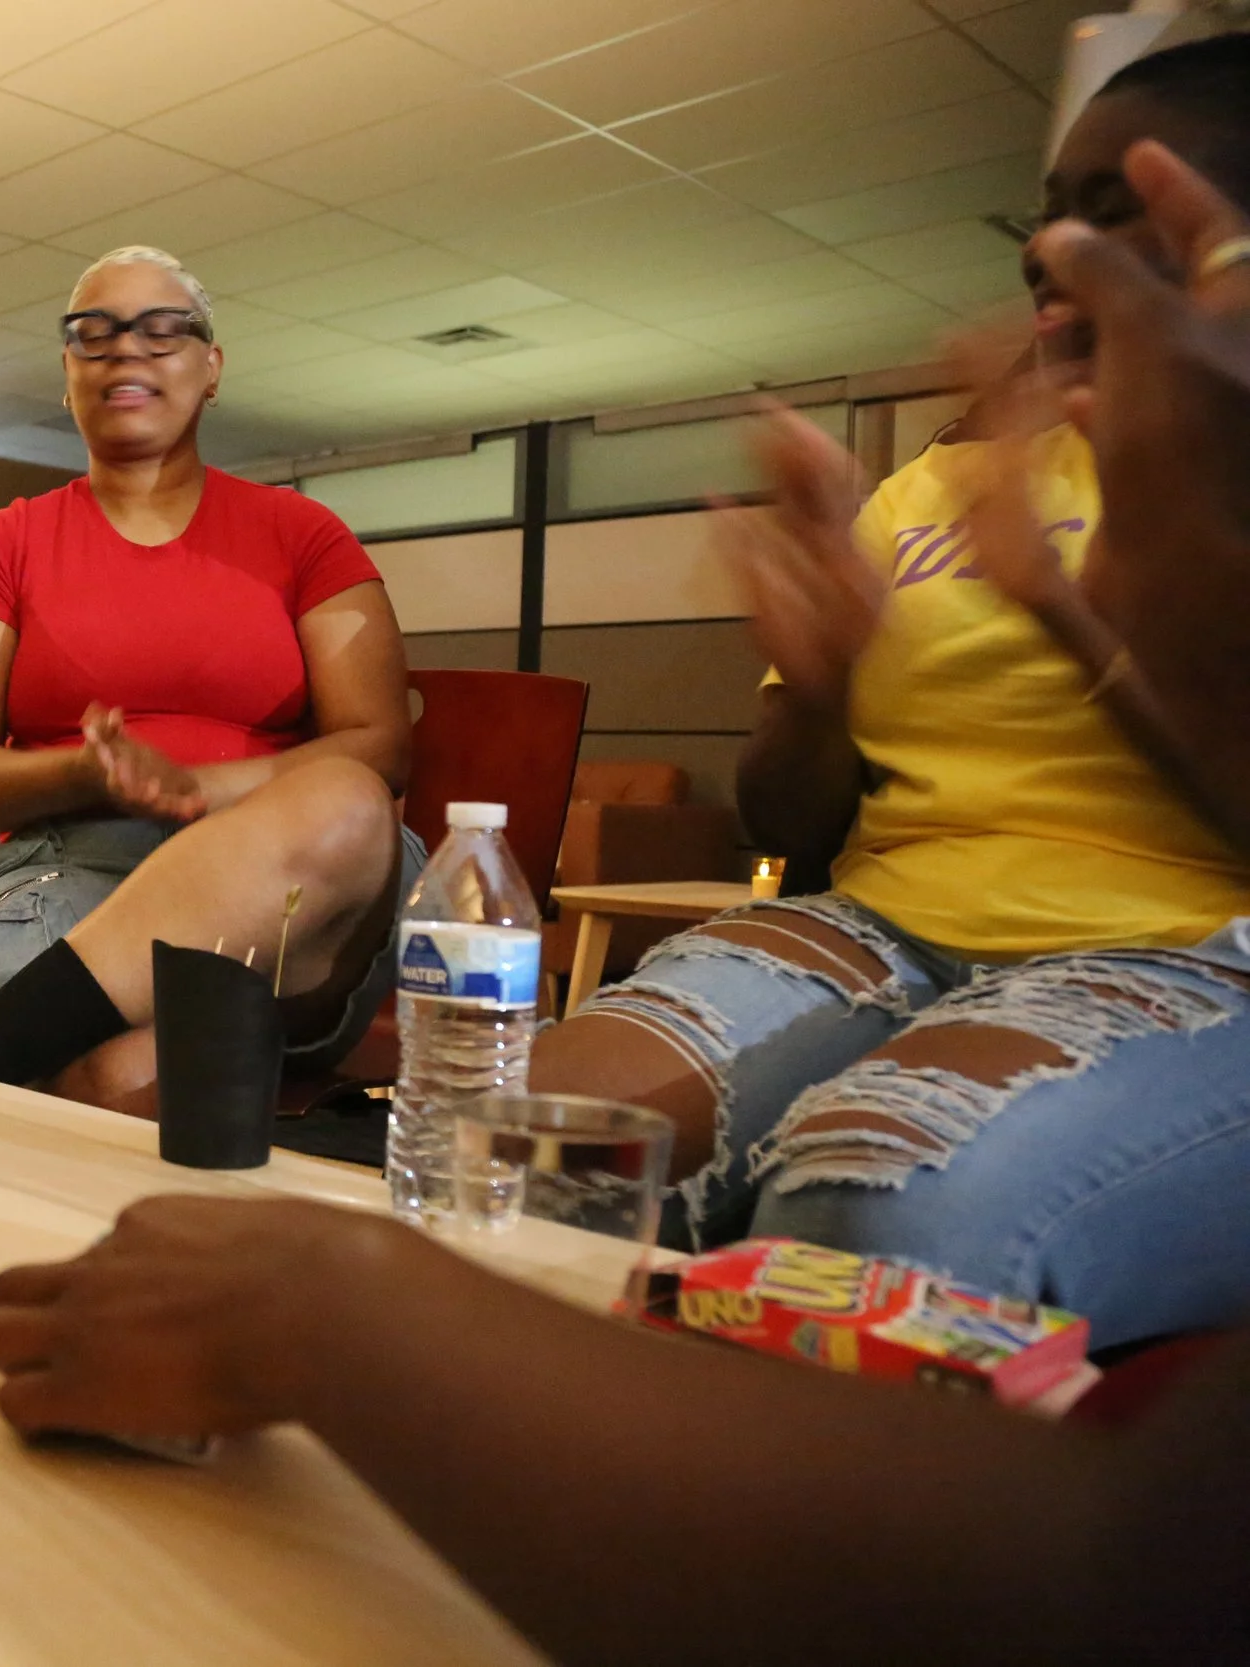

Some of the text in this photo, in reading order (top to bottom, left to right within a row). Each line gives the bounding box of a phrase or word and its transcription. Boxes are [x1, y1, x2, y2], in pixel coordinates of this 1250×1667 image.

[402, 966, 447, 984] WATER
[752, 1242, 864, 1311] UNO
[679, 1289, 762, 1328] UNO
